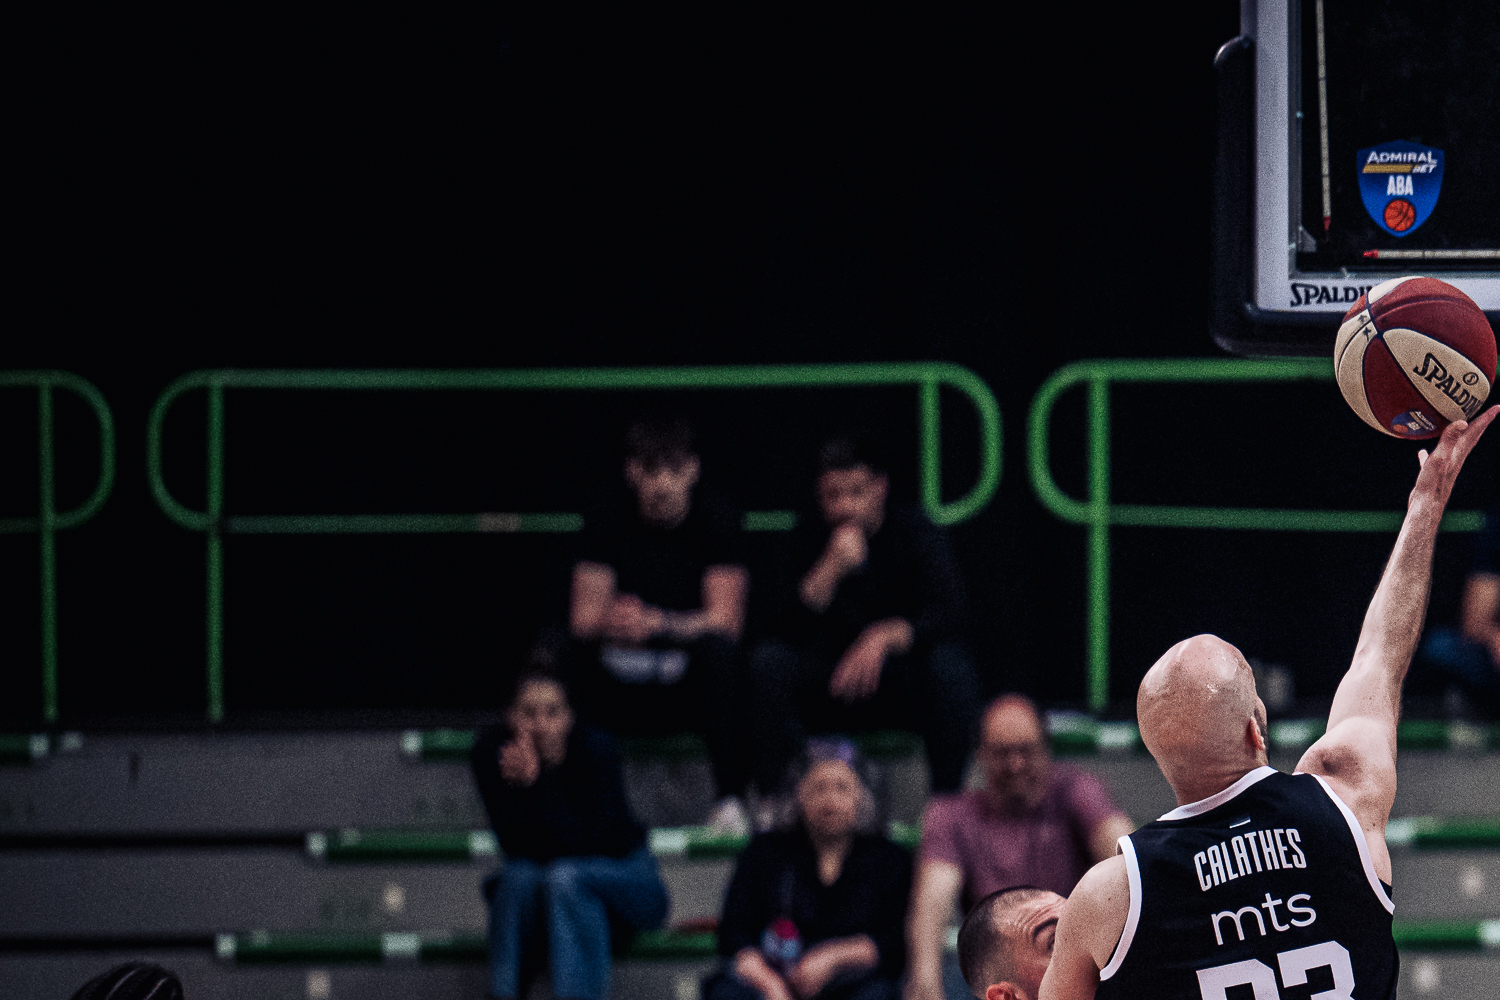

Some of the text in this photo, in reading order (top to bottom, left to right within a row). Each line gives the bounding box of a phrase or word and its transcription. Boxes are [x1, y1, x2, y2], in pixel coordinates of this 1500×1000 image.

[1366, 150, 1438, 166] ADMIRAL
[1386, 174, 1414, 196] ABA
[1290, 282, 1373, 307] SPALDI
[1194, 828, 1306, 891] CALATHES
[1210, 892, 1318, 946] mts
